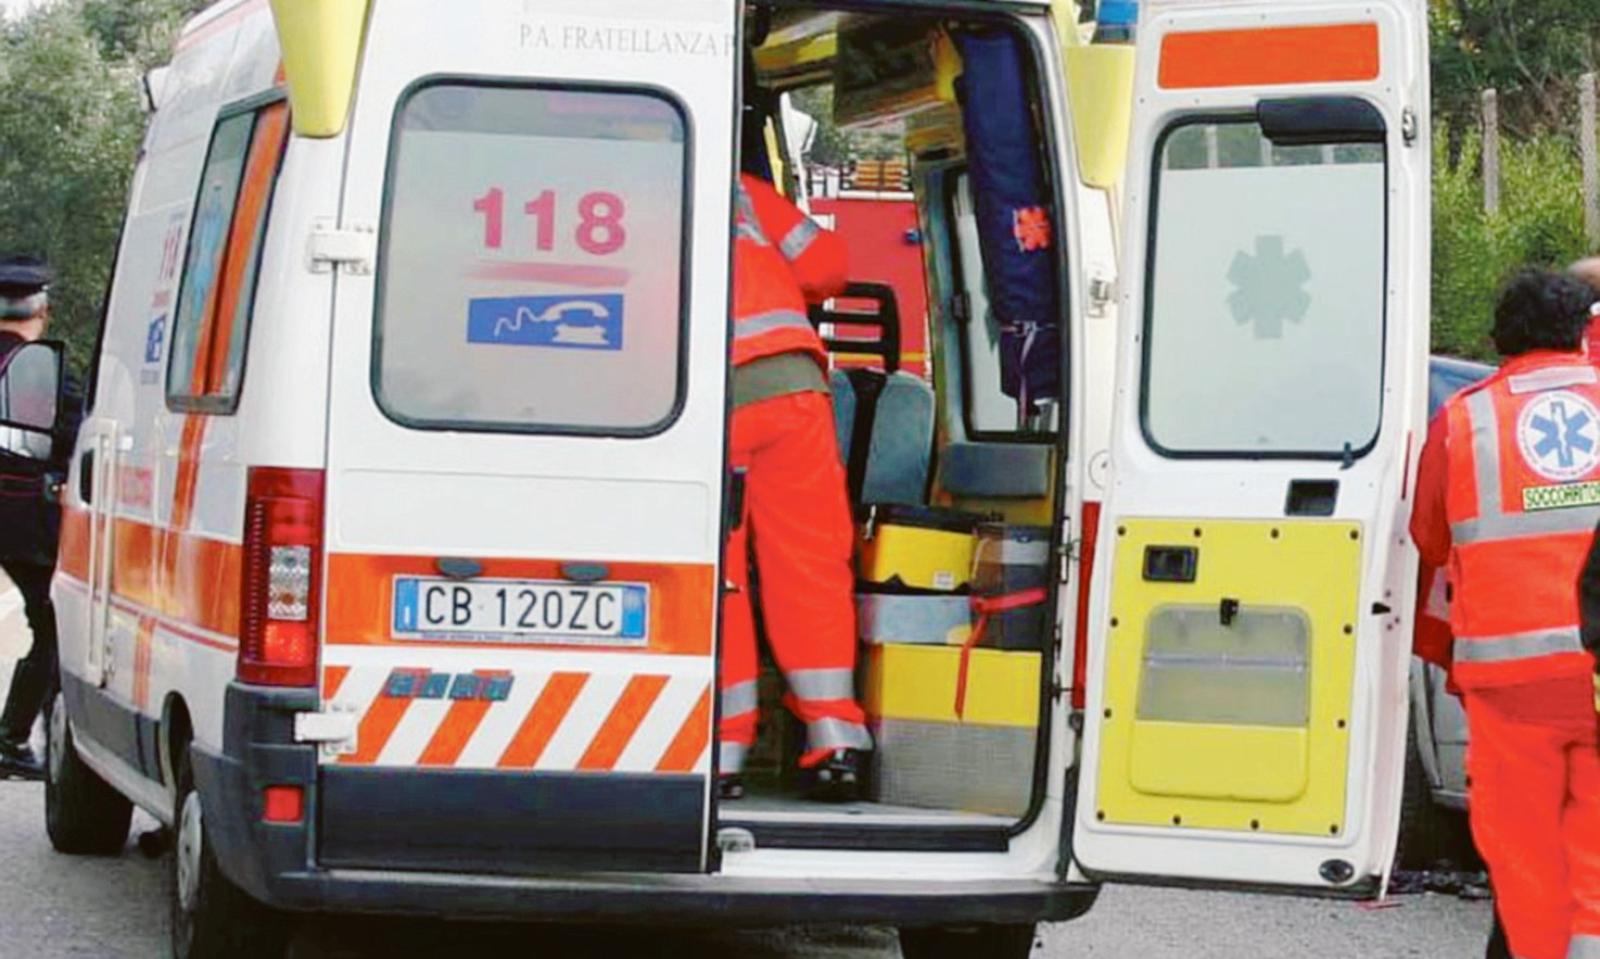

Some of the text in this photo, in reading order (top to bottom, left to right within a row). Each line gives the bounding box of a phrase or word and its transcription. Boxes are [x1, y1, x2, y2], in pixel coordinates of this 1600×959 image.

[562, 26, 718, 56] FRATELLANZA
[473, 187, 626, 256] 118
[425, 586, 616, 631] CB 120ZC
